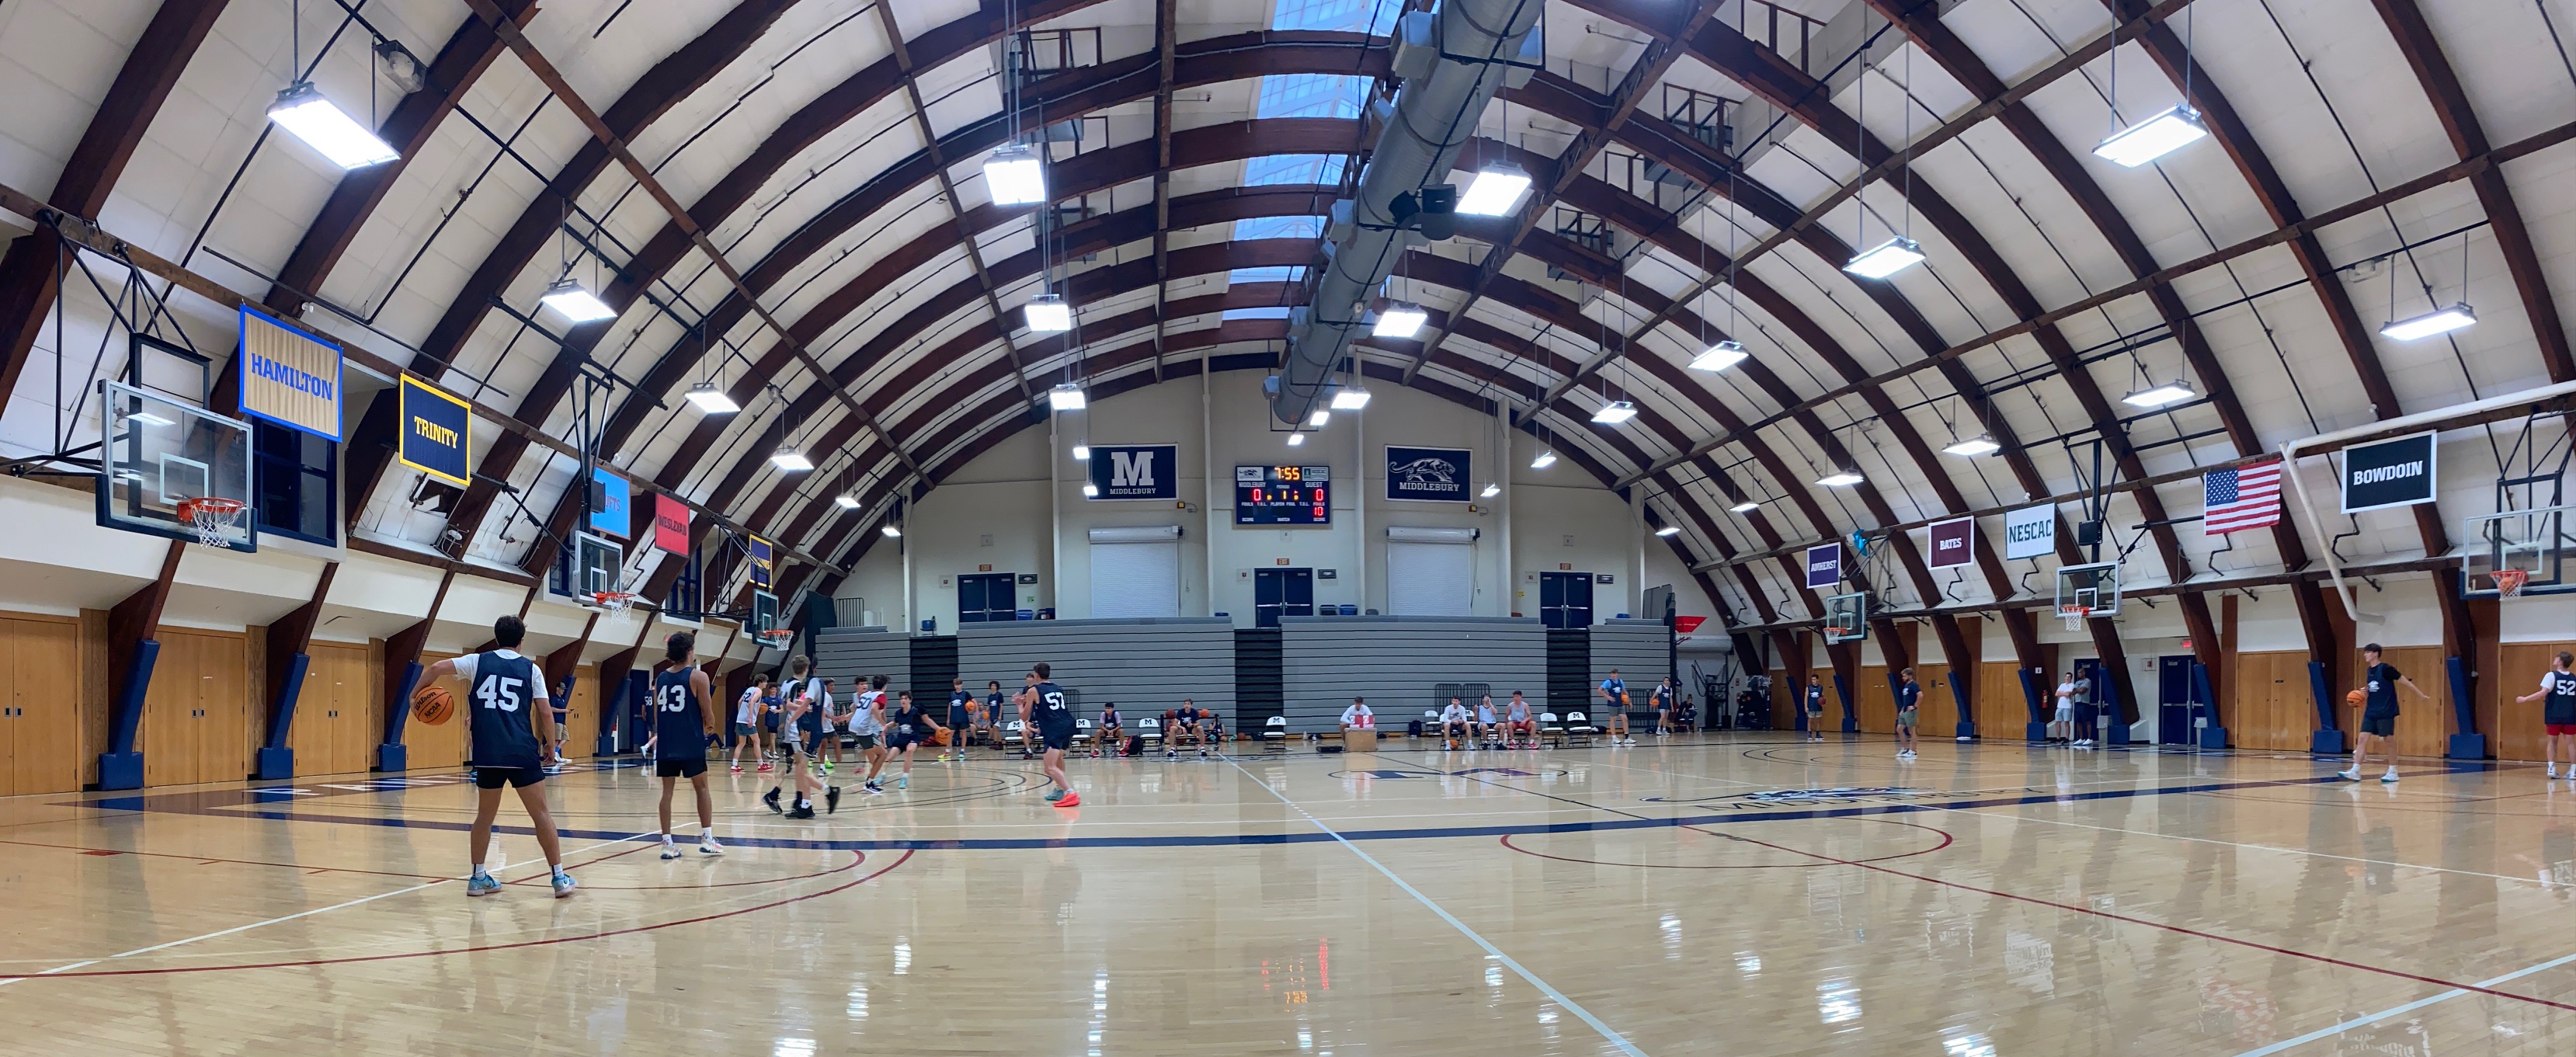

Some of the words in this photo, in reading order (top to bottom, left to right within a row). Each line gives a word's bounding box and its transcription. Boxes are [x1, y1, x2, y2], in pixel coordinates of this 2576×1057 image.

[251, 352, 332, 401] HAMILTON
[414, 415, 458, 449] TRINITY
[1111, 451, 1155, 486] M
[1274, 467, 1300, 481] 7:55
[2353, 461, 2423, 485] BOWDOIN
[1253, 489, 1261, 501] 0
[1316, 489, 1324, 502] 0
[1399, 482, 1460, 492] MIDDLEBURY
[1314, 506, 1324, 516] 10
[658, 513, 687, 537] WESLEYAN
[2008, 519, 2052, 544] NESCAC
[1939, 537, 1962, 551] BATES
[476, 674, 523, 713] 45
[656, 684, 686, 712] 43
[2557, 680, 2576, 696] 52
[415, 691, 436, 712] Wilson
[424, 701, 441, 718] NCAA
[644, 696, 653, 706] 58
[1045, 691, 1066, 711] 57
